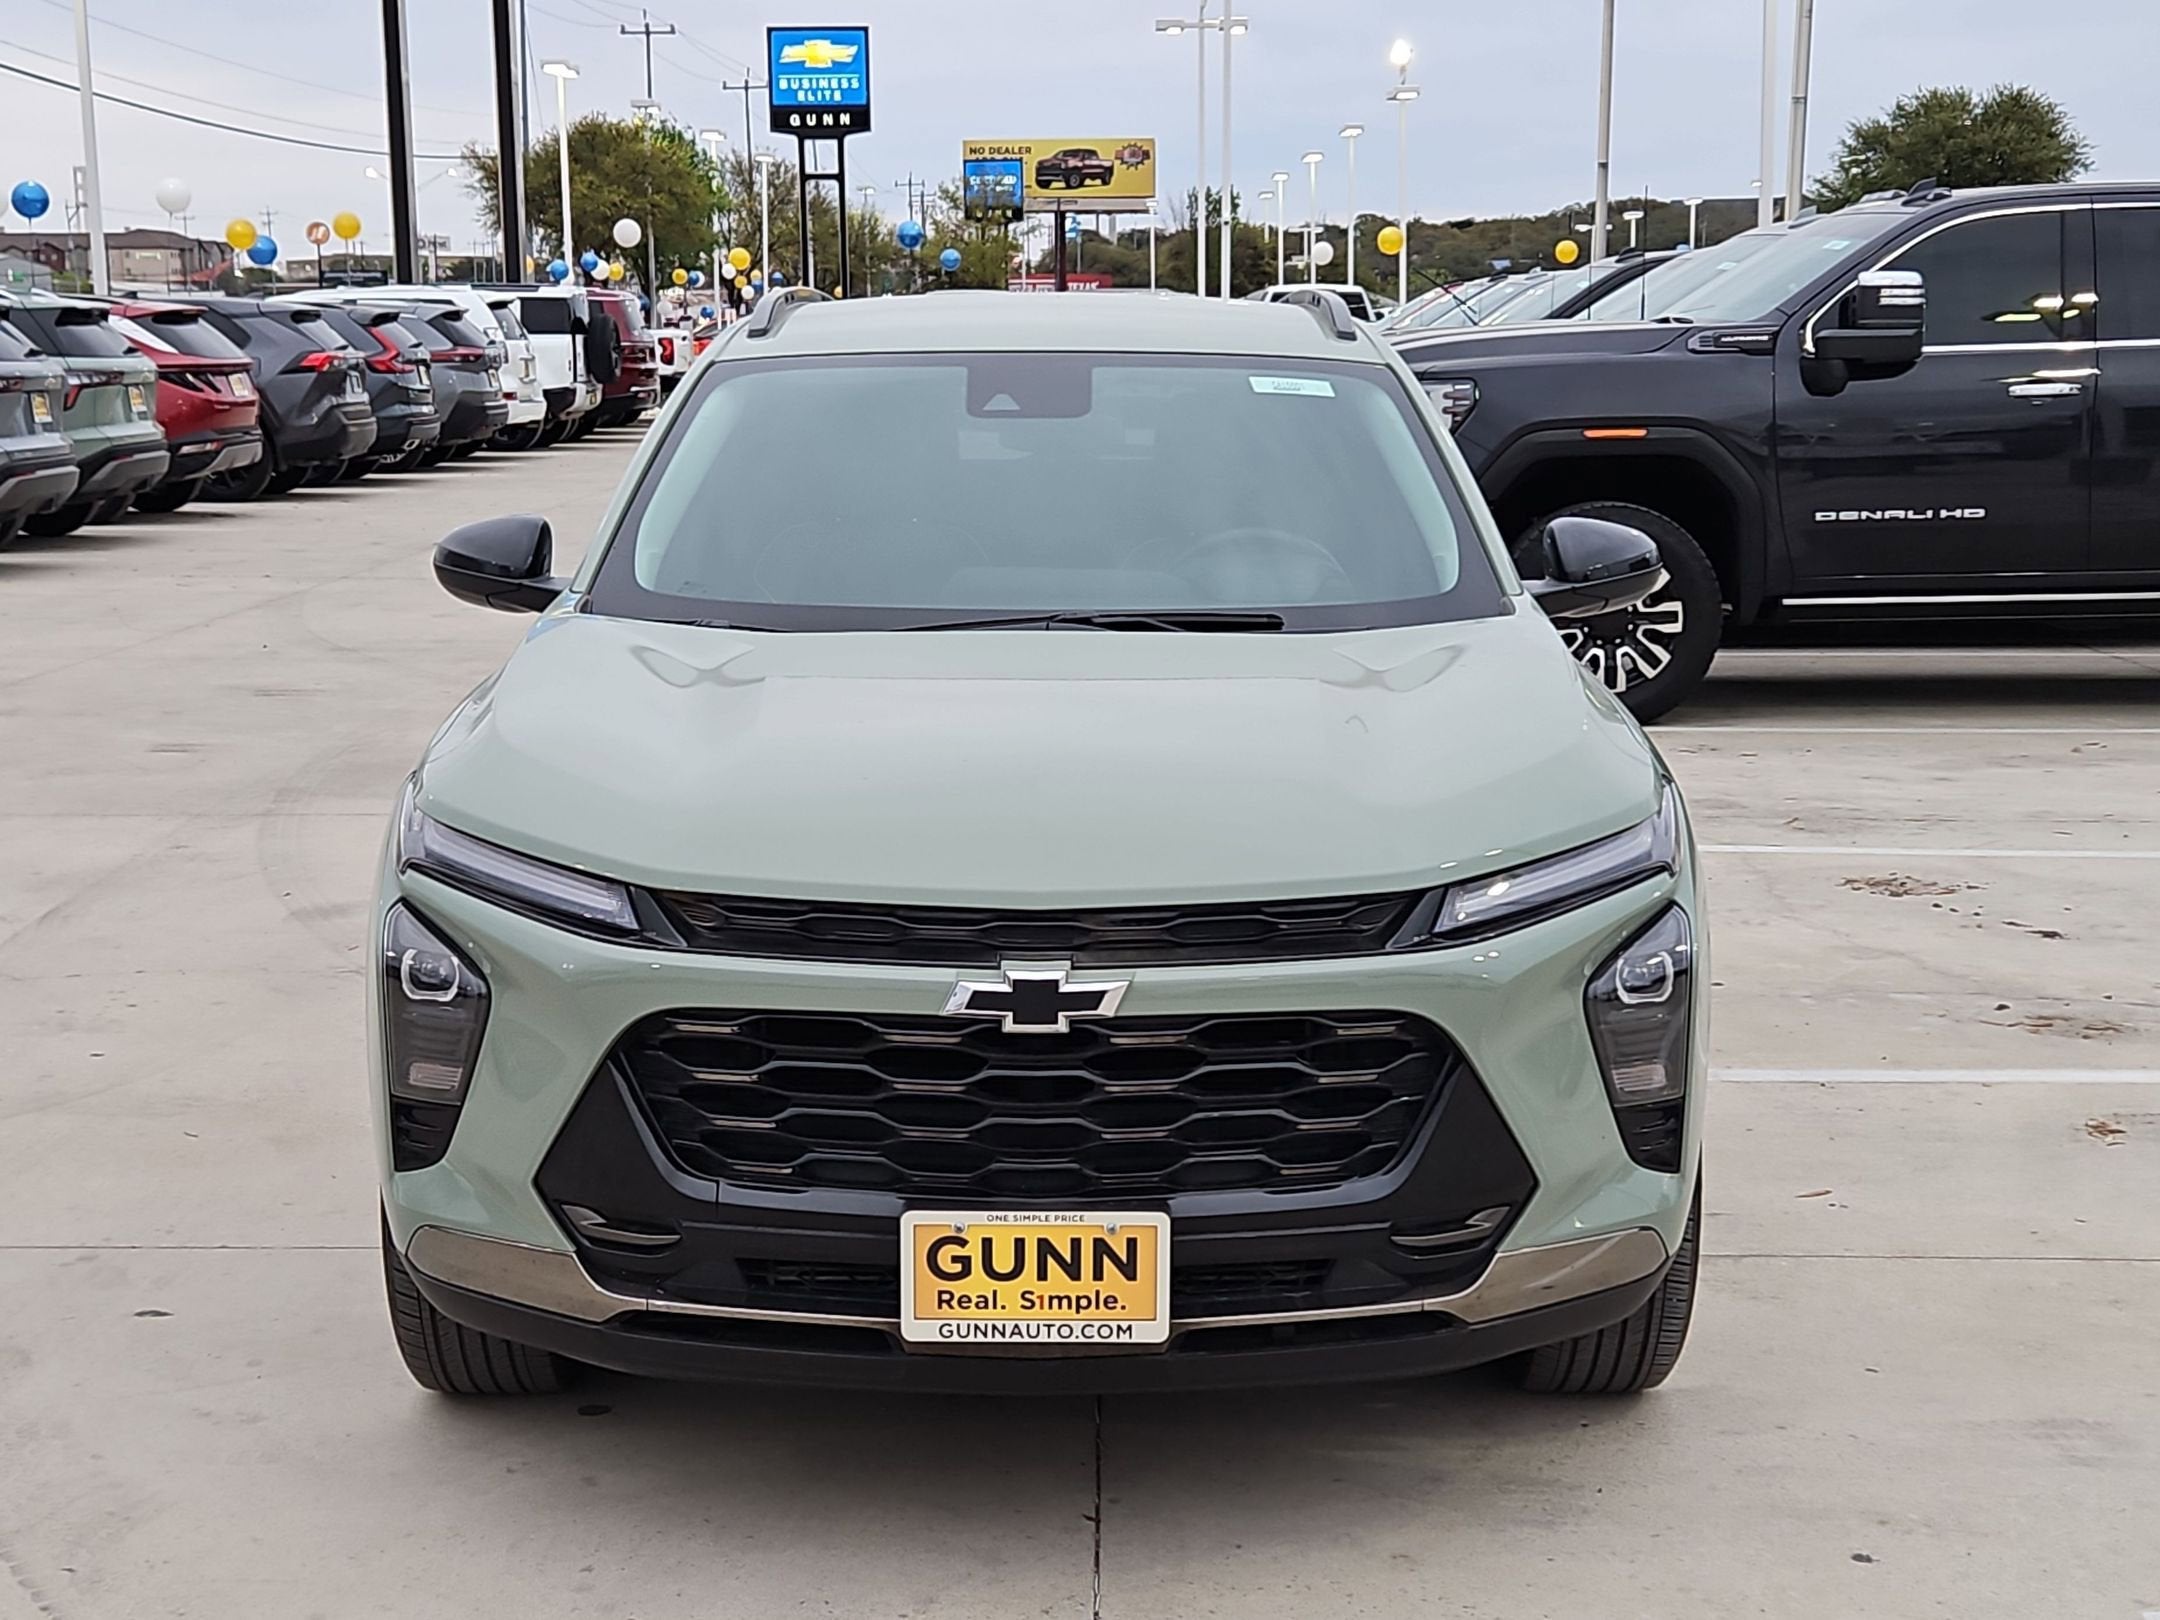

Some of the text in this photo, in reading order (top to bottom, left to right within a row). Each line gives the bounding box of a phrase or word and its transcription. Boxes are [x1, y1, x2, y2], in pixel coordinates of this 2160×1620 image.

[778, 78, 860, 90] BUSINESS
[797, 90, 842, 102] ELITE
[789, 112, 851, 127] GUNN
[969, 145, 1033, 155] NO DEALER
[1814, 508, 1986, 522] DENALI HD
[986, 1214, 1085, 1223] ONE SIMPLE PRICE
[926, 1235, 1138, 1282] GUNN
[937, 1289, 1007, 1311] Real.
[938, 1323, 1133, 1340] GUNNAUTO.COM
